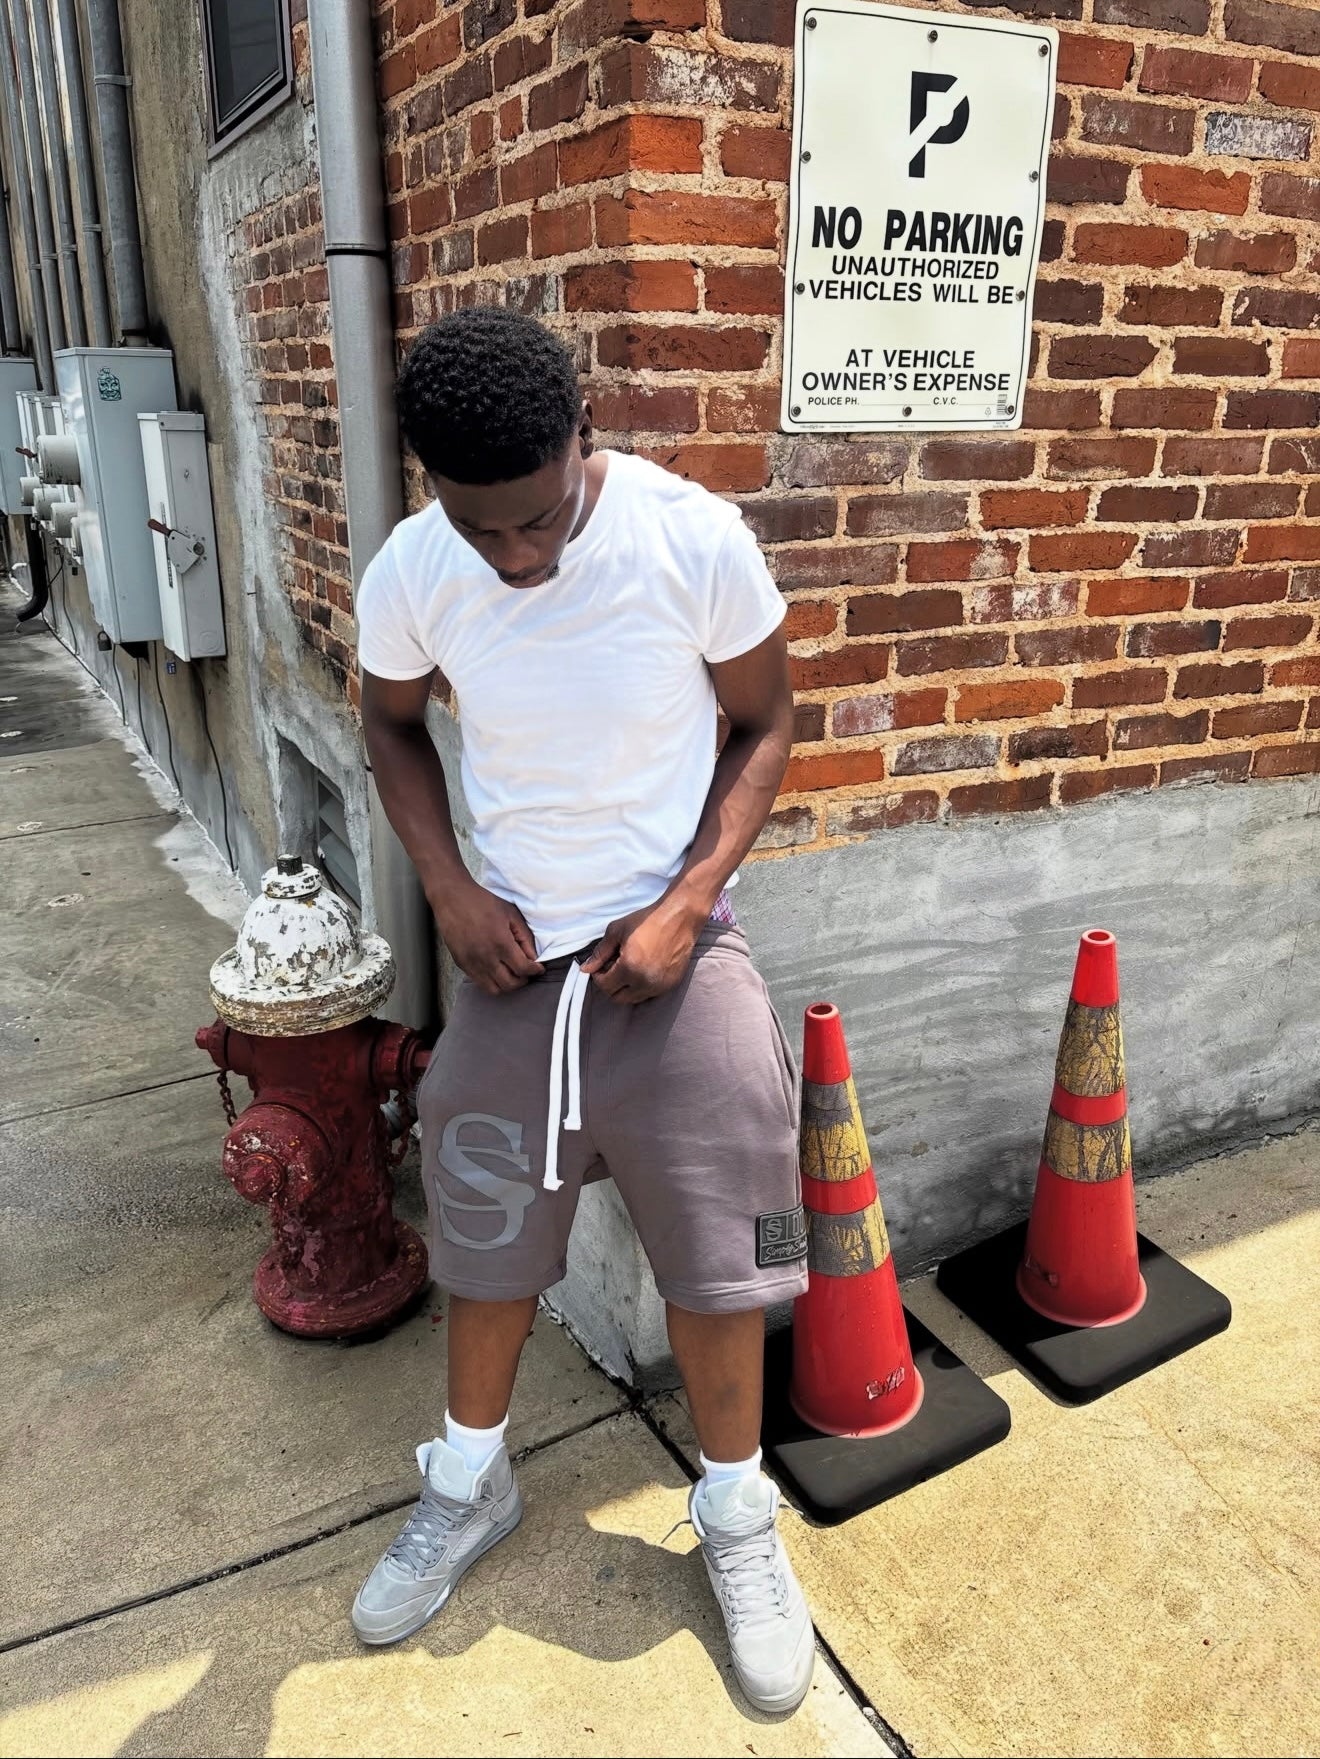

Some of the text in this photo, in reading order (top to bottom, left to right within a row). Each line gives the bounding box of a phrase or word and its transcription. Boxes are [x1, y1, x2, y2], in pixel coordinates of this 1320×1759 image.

[811, 205, 1024, 257] NO PARKING
[831, 254, 999, 280] UNAUTHORIZED
[809, 279, 1015, 305] VEHICLES WILL BE
[845, 348, 975, 369] AT VEHICLE
[801, 371, 1011, 391] OWNER'S EXPENSE
[808, 396, 860, 406] POLICE PH.
[933, 396, 959, 406] C.V.C.
